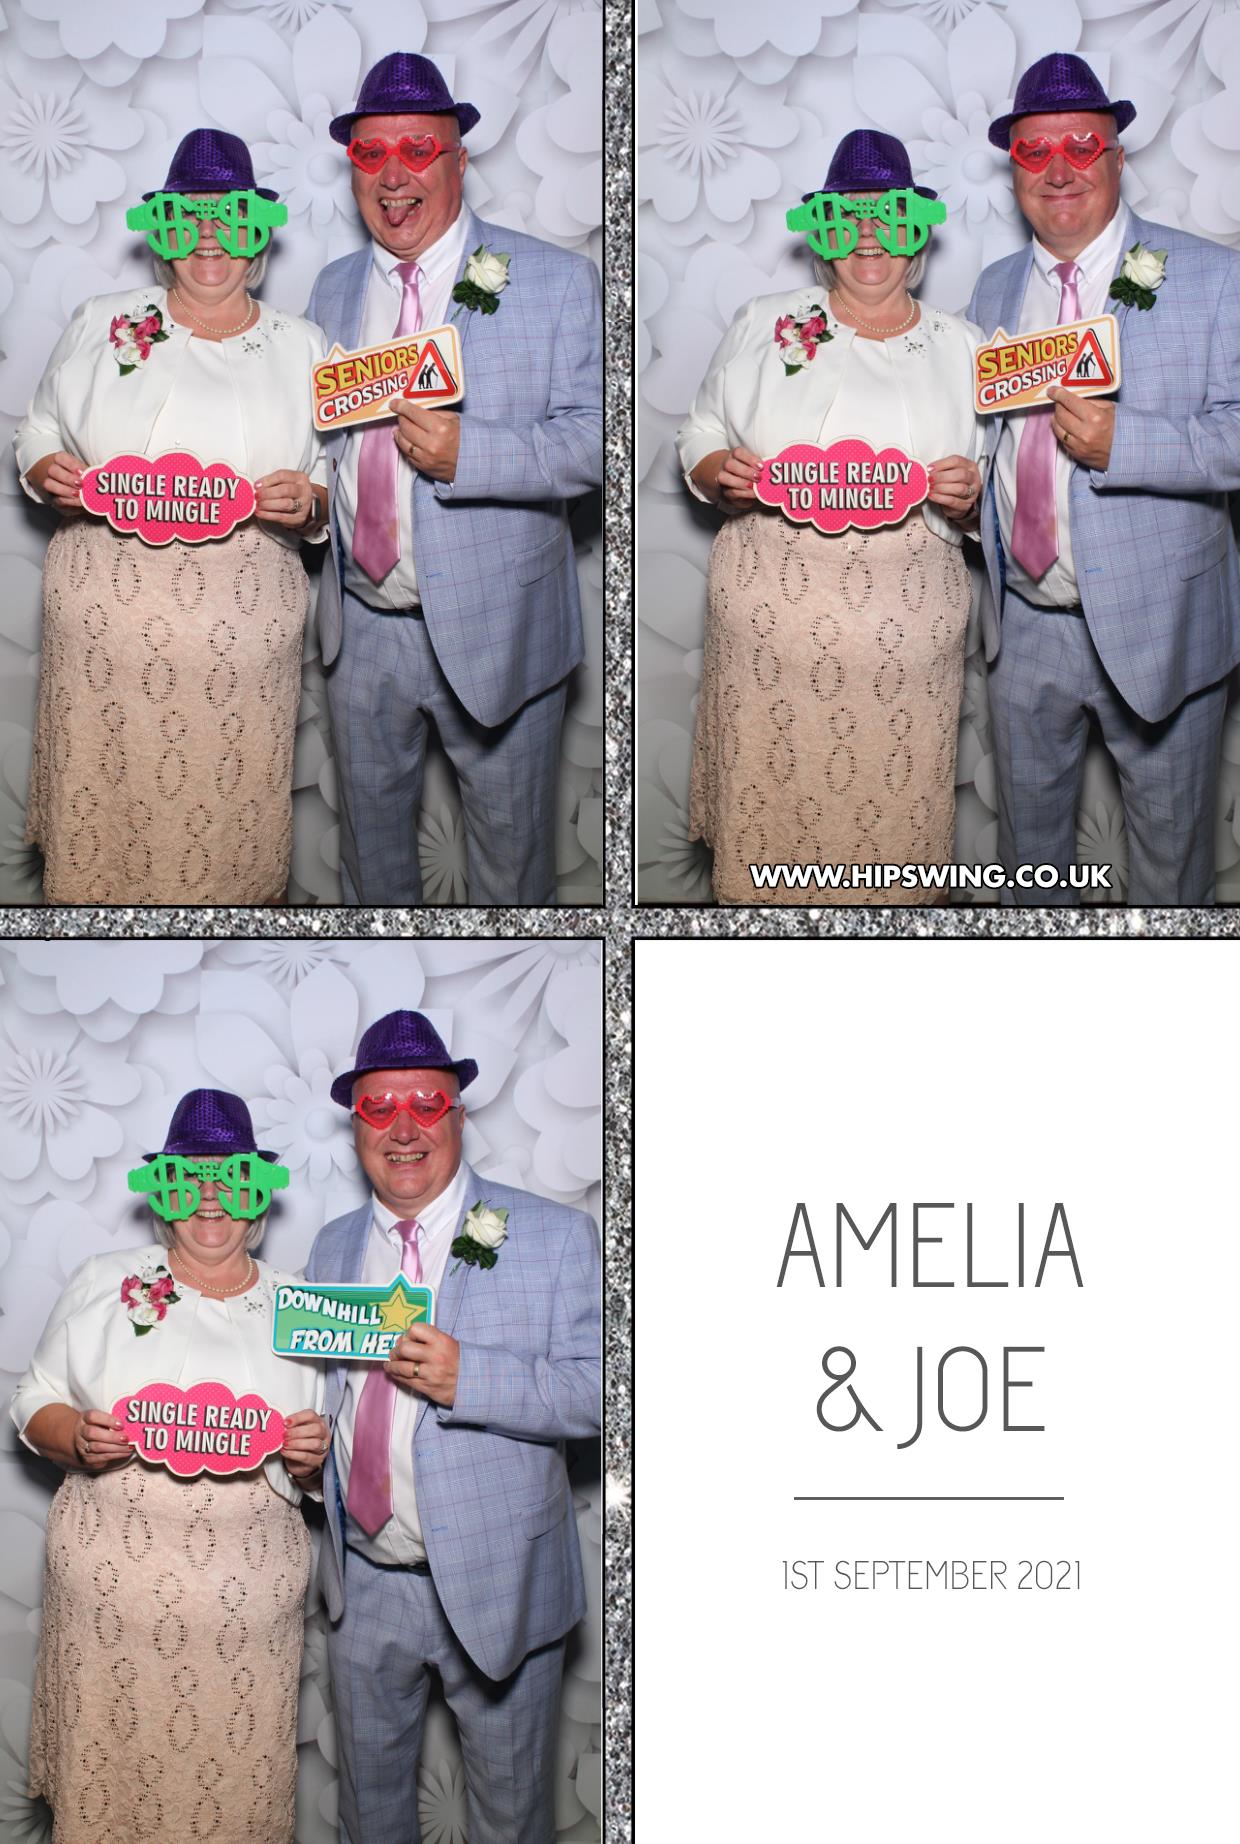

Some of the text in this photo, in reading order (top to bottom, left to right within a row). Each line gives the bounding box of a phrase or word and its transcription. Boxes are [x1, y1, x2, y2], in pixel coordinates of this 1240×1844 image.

[316, 343, 419, 397] SENIORS
[978, 333, 1078, 380] SENIORS
[319, 372, 409, 422] CROSSING
[980, 360, 1067, 405] CROSSING
[97, 472, 240, 500] SINGLE READY
[770, 462, 913, 485] SINGLE READY
[114, 498, 220, 525] TO MINGLE
[787, 487, 894, 511] TO MINGLE
[278, 1287, 382, 1326] DOWNHILL
[290, 1330, 352, 1353] FROM
[127, 1400, 273, 1432] SINGLE READY
[144, 1427, 252, 1457] TO MINGLE
